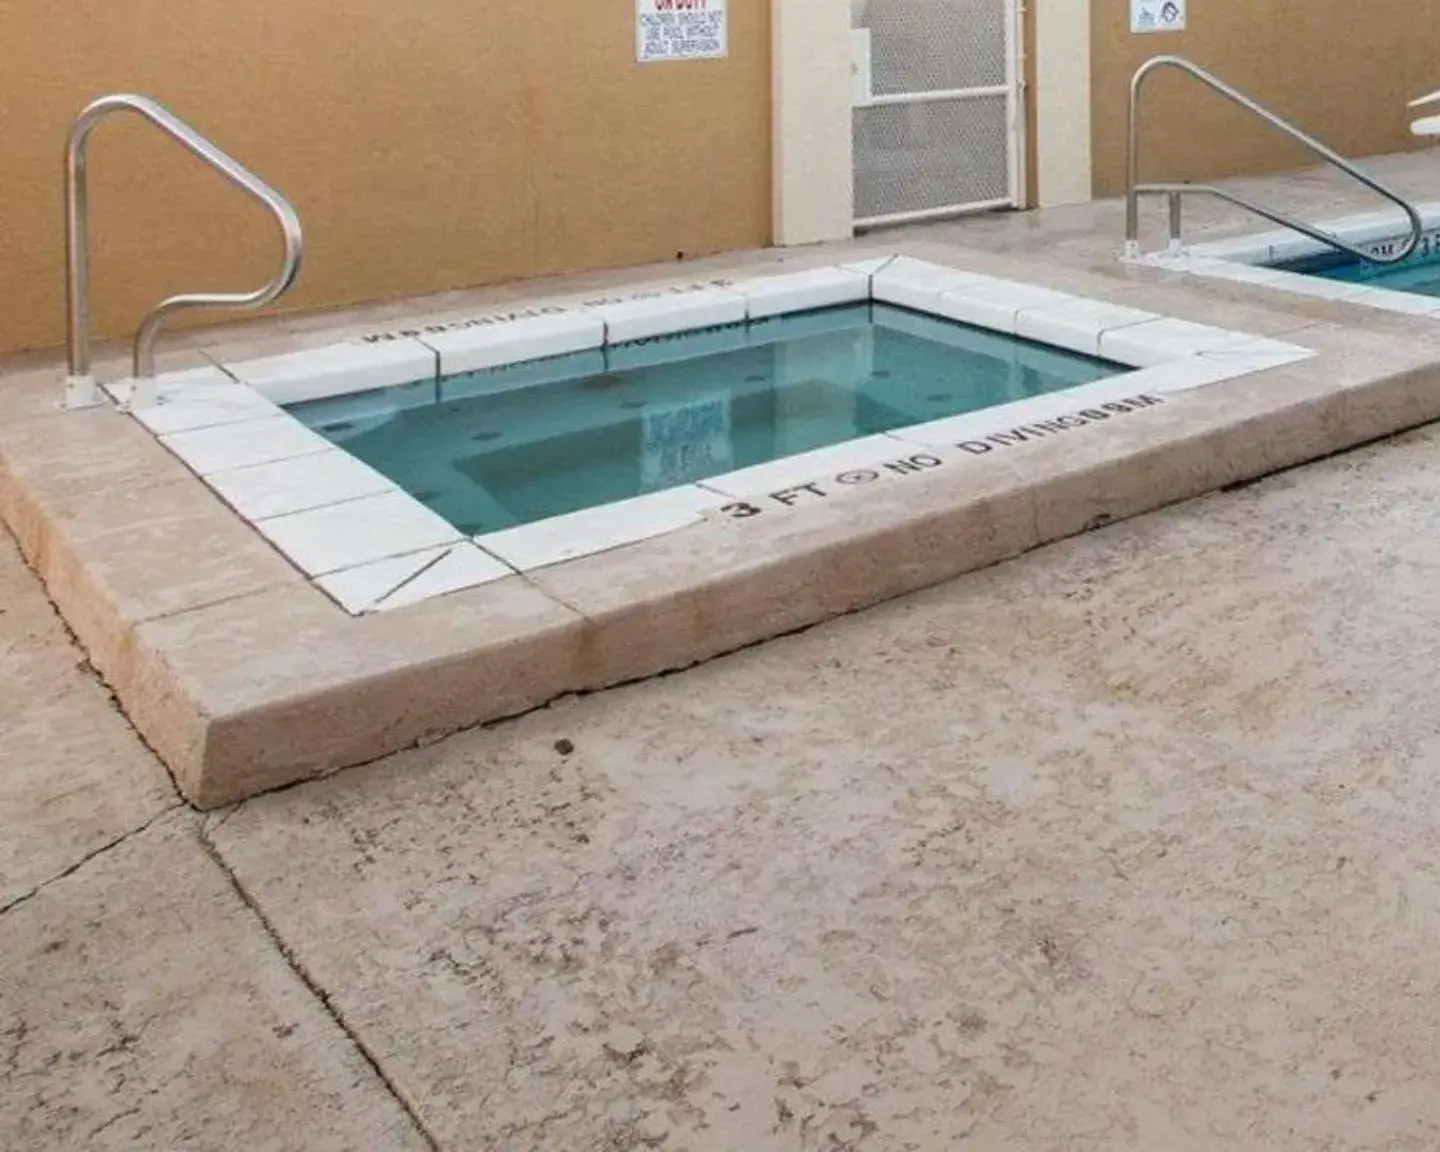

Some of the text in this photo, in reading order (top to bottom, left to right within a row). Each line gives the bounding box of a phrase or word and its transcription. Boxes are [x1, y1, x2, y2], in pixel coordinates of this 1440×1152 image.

[720, 501, 762, 519] 3
[768, 481, 828, 507] FT
[883, 453, 943, 476] NO
